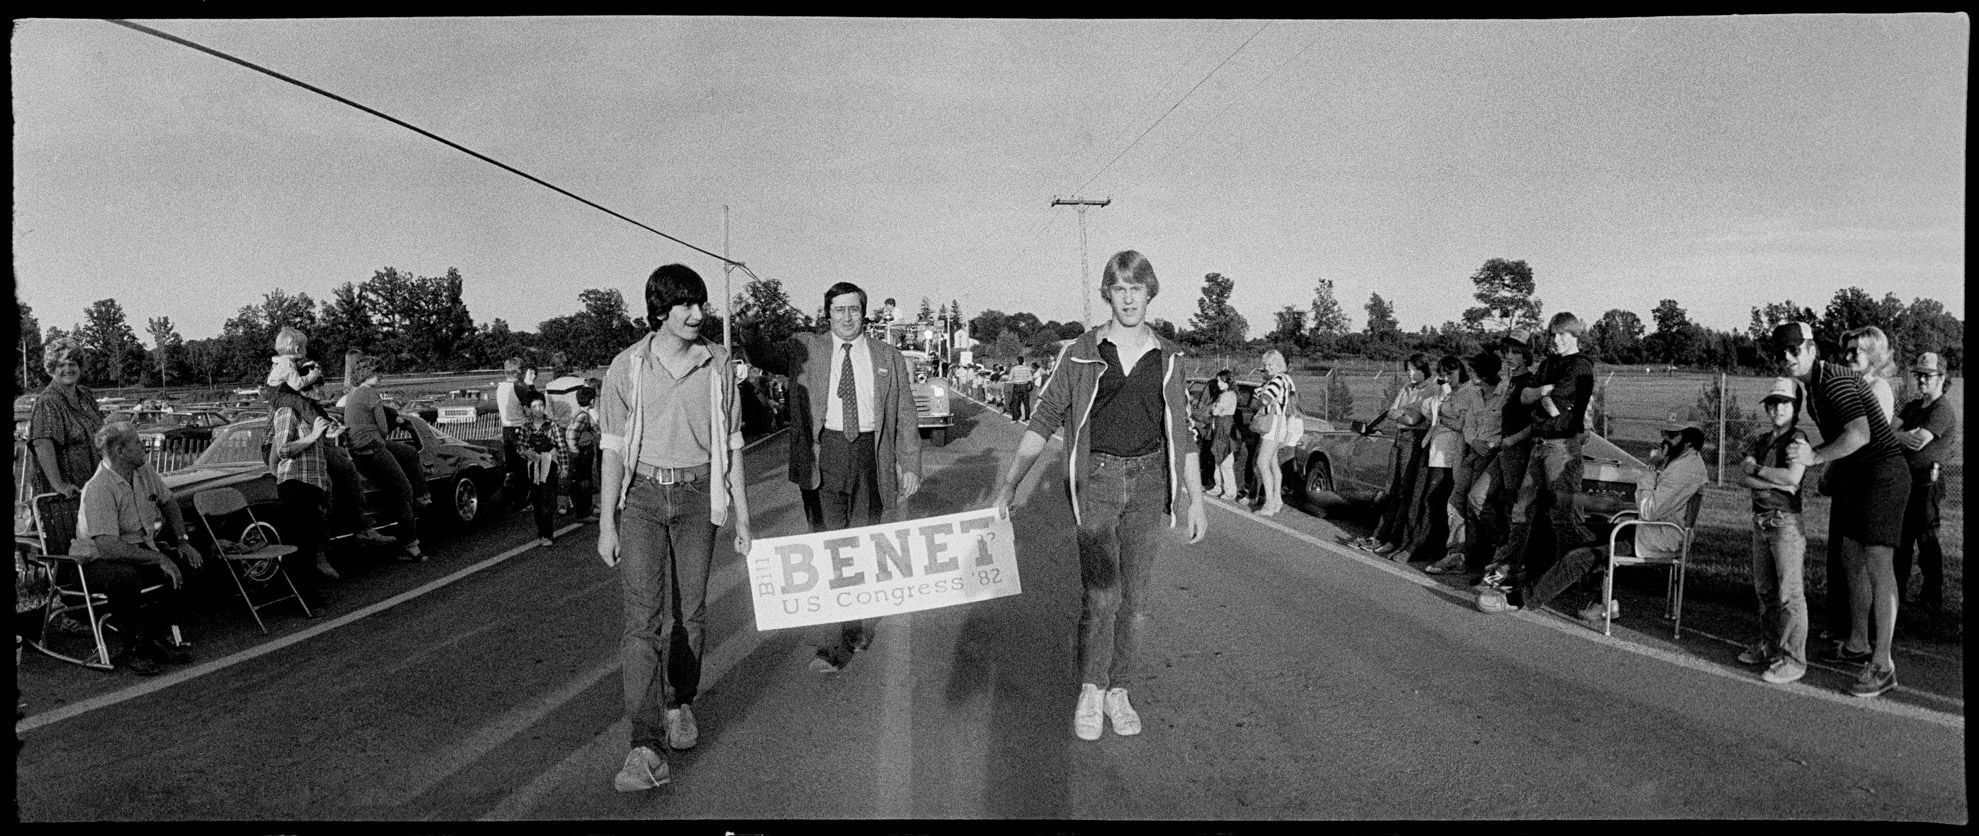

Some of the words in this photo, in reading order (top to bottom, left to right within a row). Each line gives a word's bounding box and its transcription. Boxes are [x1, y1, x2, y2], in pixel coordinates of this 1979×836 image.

[754, 558, 775, 597] Bill
[774, 516, 995, 595] BENET
[782, 596, 820, 614] US
[836, 577, 964, 606] Congress
[971, 568, 1002, 585] '82
